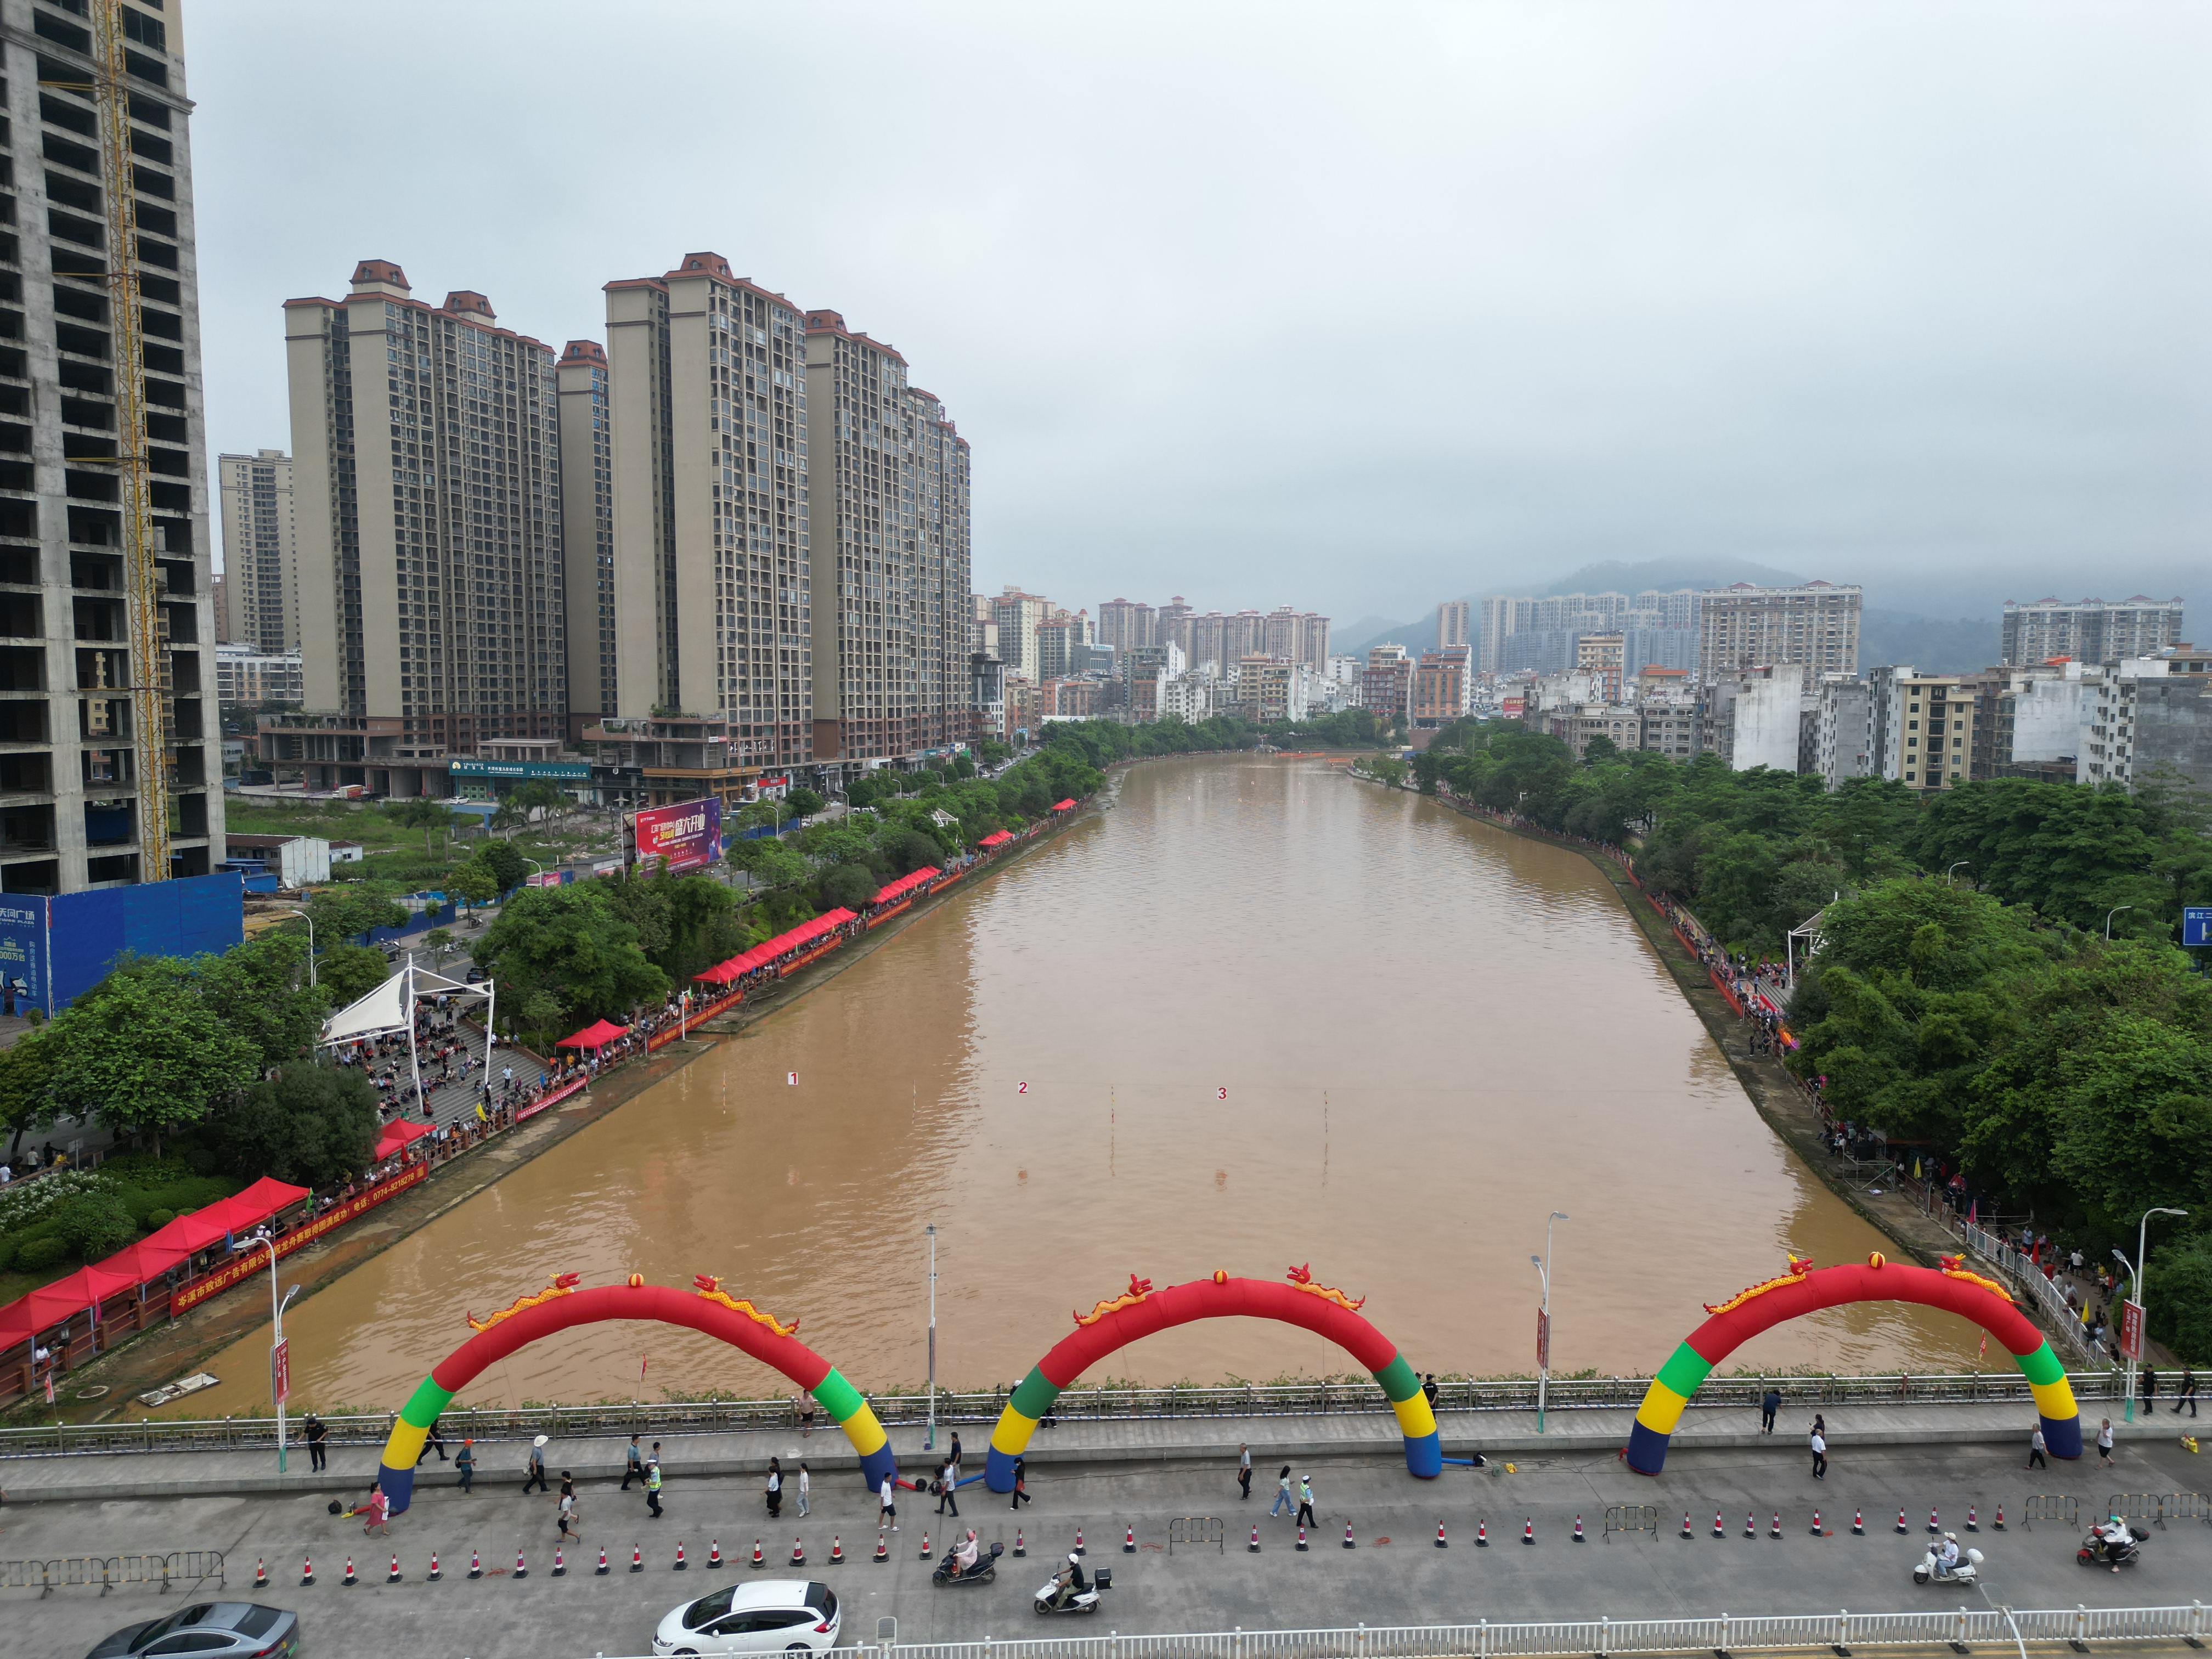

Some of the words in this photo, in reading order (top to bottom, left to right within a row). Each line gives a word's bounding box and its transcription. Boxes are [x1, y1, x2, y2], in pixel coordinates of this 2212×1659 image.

[675, 813, 706, 836] 盛大开业
[791, 1073, 797, 1085] 1
[1019, 1081, 1027, 1093] 2
[1218, 1087, 1227, 1099] 3
